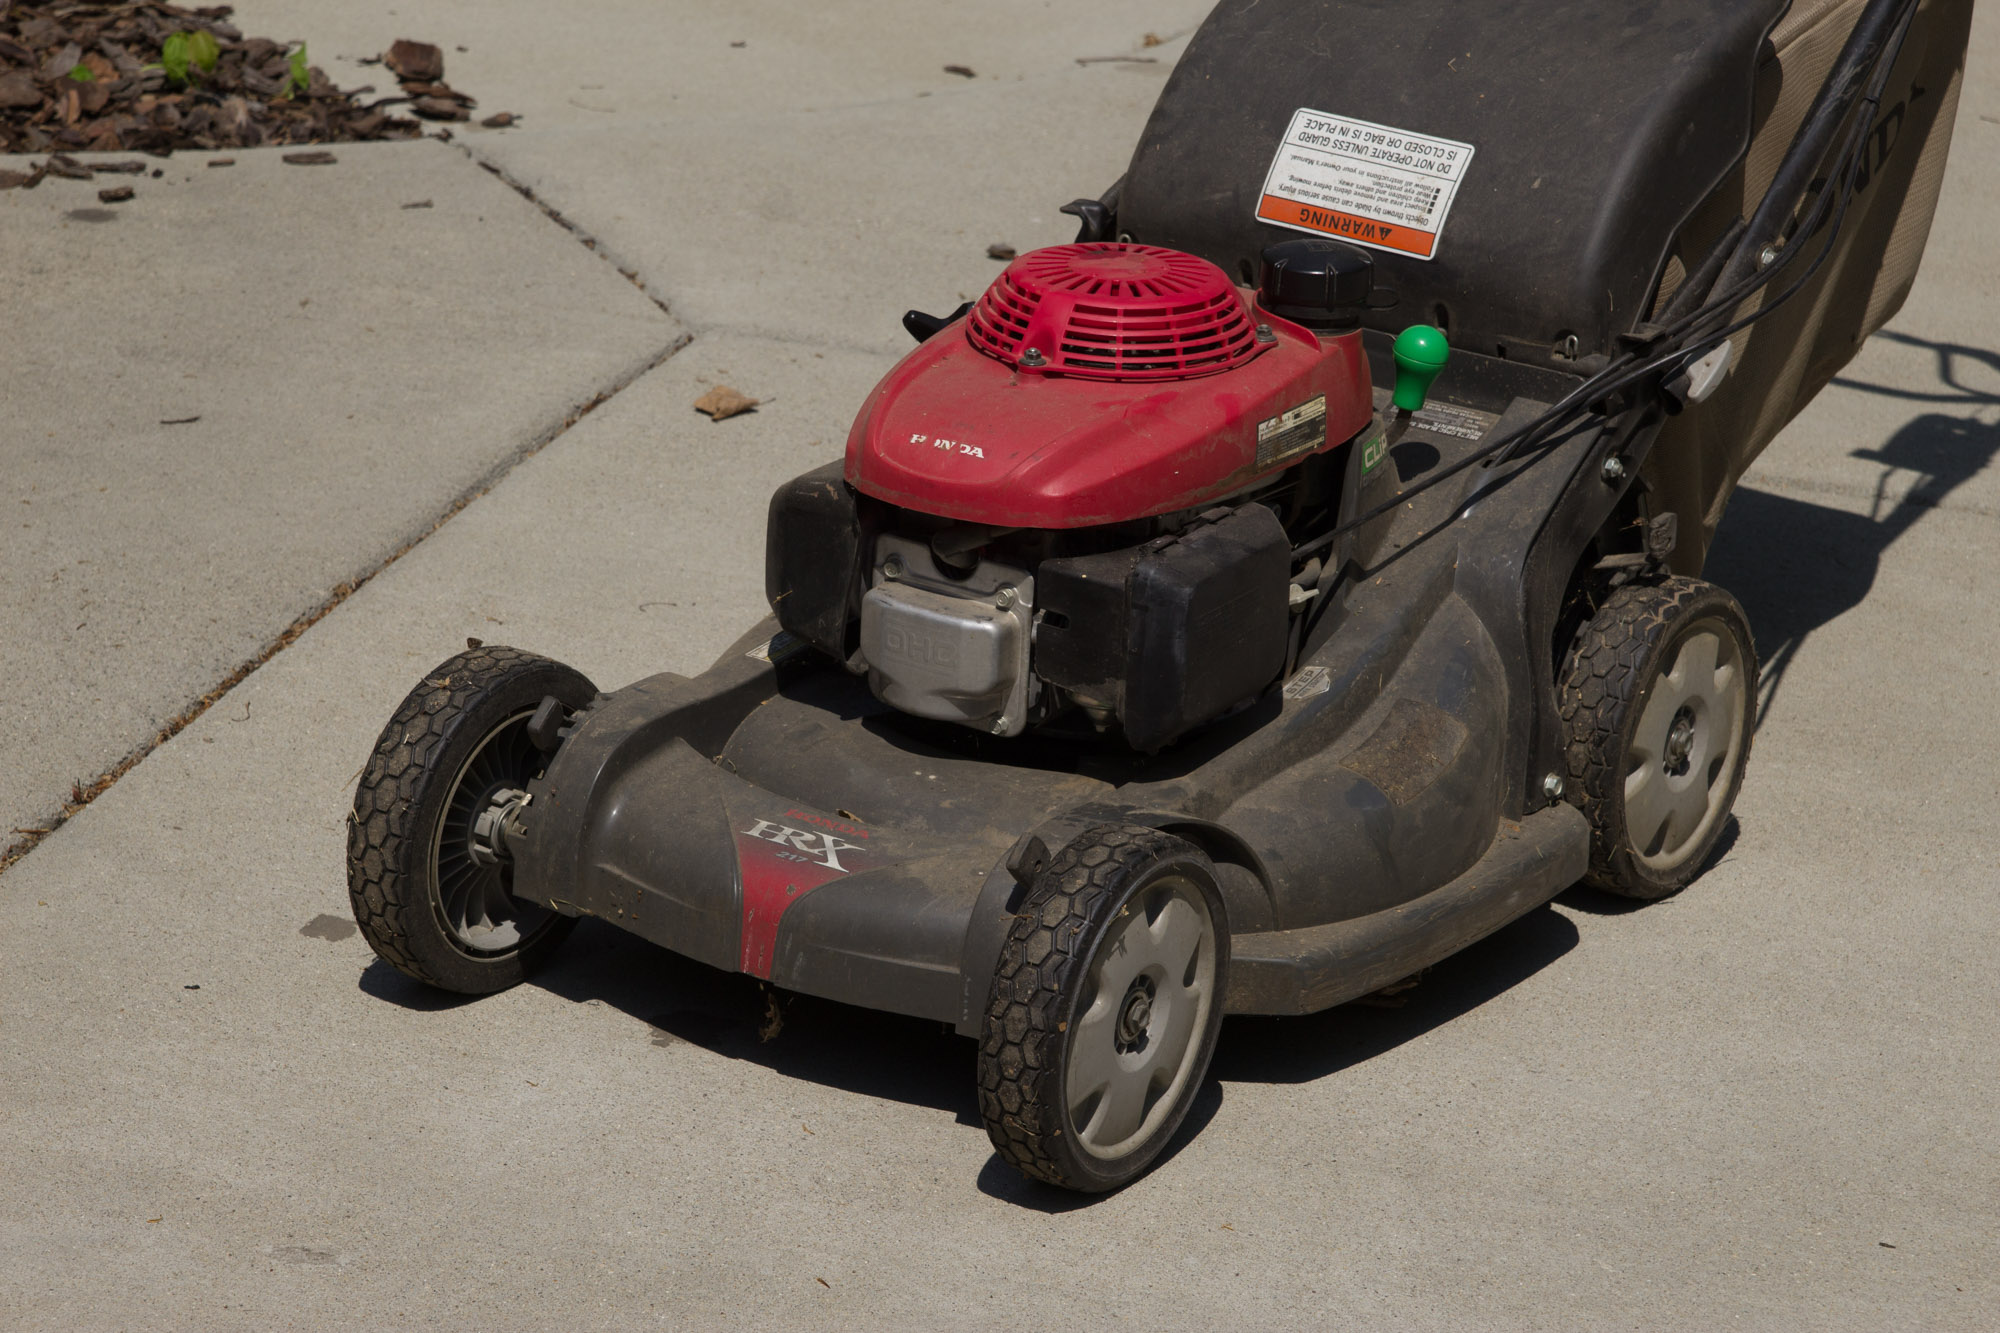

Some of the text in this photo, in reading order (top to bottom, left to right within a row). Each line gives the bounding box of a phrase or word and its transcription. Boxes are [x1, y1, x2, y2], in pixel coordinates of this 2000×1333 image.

[1303, 118, 1457, 160] IS CLOSED OR BAG IS IN PLACE
[1297, 131, 1451, 174] DO NOT OPERATE UNLESS GUARD
[1290, 154, 1315, 165] Manual.
[1315, 159, 1341, 171] Owner's
[1338, 178, 1354, 187] away.
[1365, 171, 1403, 185] instructions
[1278, 183, 1296, 195] injury.
[1355, 183, 1374, 192] others
[1371, 180, 1403, 191] protection.
[1413, 182, 1434, 192] Follow
[1288, 174, 1427, 213] Inspect area and remove debris before mowing.
[1296, 188, 1320, 199] serious
[1320, 194, 1340, 204] cause
[1387, 191, 1412, 201] children
[1415, 190, 1431, 199] Wear
[1354, 201, 1372, 213] blade
[1413, 196, 1429, 206] Keep
[1372, 205, 1381, 215] by
[1381, 208, 1404, 219] thrown
[1299, 207, 1375, 238] WARNING
[1404, 213, 1429, 226] Objects
[1417, 422, 1439, 431] BLADE
[1433, 421, 1482, 436] REQUIREMENTS
[910, 433, 984, 458] HNDA
[1364, 433, 1388, 468] CLIP
[1285, 670, 1315, 694] STEP
[784, 808, 869, 840] HONDA
[740, 818, 866, 873] HRX
[775, 851, 808, 863] 217
